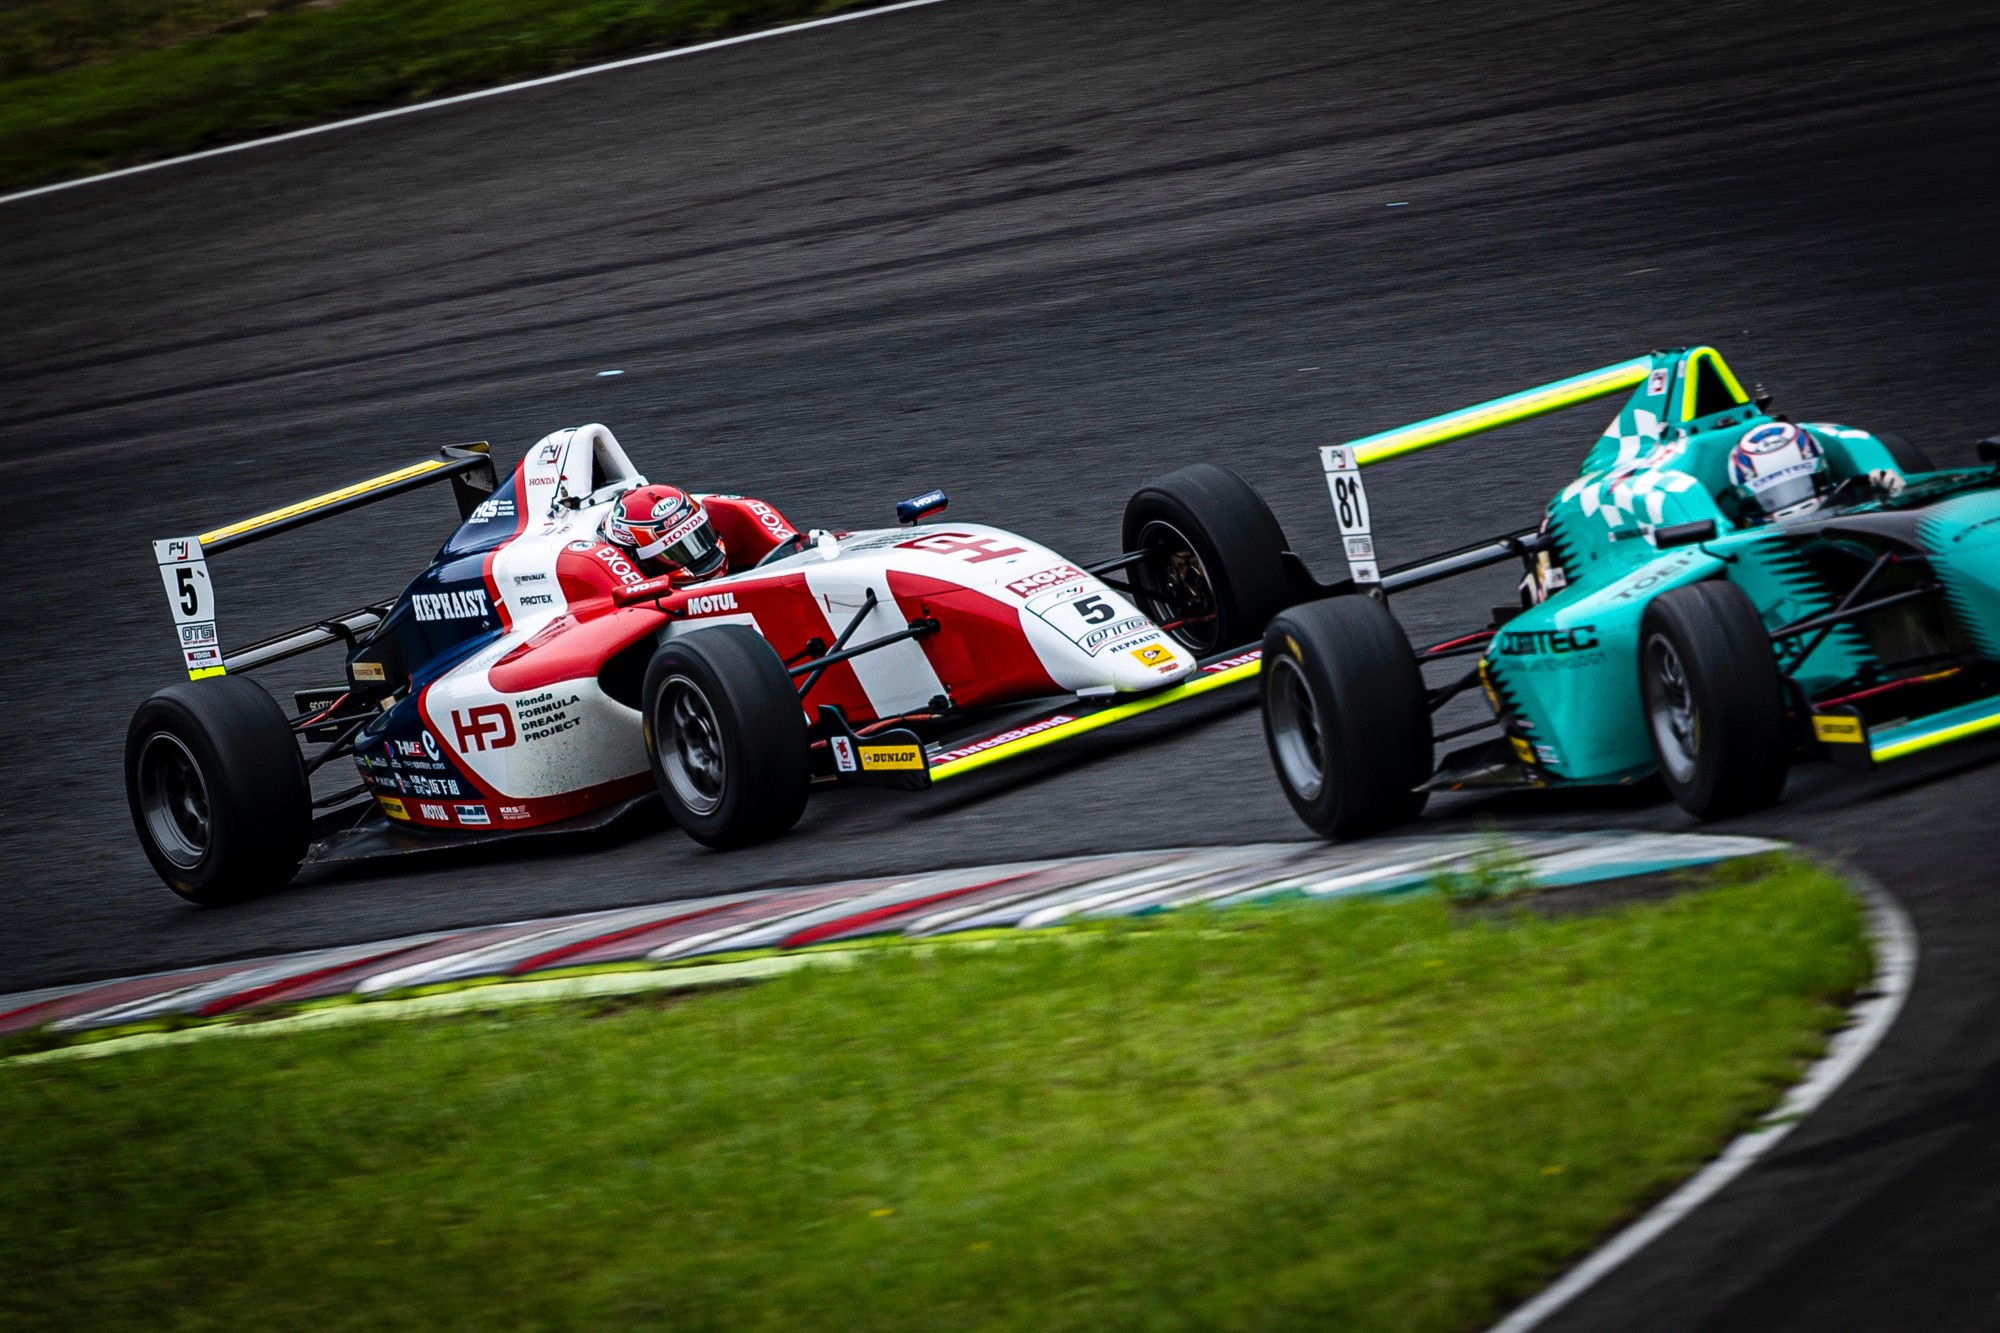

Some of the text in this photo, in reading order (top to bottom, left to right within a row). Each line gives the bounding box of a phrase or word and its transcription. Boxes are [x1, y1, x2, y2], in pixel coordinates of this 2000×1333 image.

[528, 477, 556, 487] HONDA
[653, 498, 677, 517] Arai
[1335, 476, 1362, 529] 81
[661, 515, 703, 547] HONDA
[176, 567, 198, 616] 5
[1010, 566, 1078, 593] NGK
[411, 589, 489, 622] HEPHAIST
[519, 594, 553, 607] PROTEX
[687, 592, 738, 616] MOTUL
[1073, 595, 1115, 625] 5
[1110, 632, 1161, 654] HEPHAIST
[516, 693, 553, 708] Honda
[518, 695, 580, 719] FORMULA
[521, 711, 567, 731] DREAM
[524, 717, 580, 742] PROJECT
[930, 715, 1073, 763] ThreeBond
[873, 752, 916, 762] DUNLOP
[420, 804, 449, 821] MOTUL
[500, 806, 519, 814] KRS
